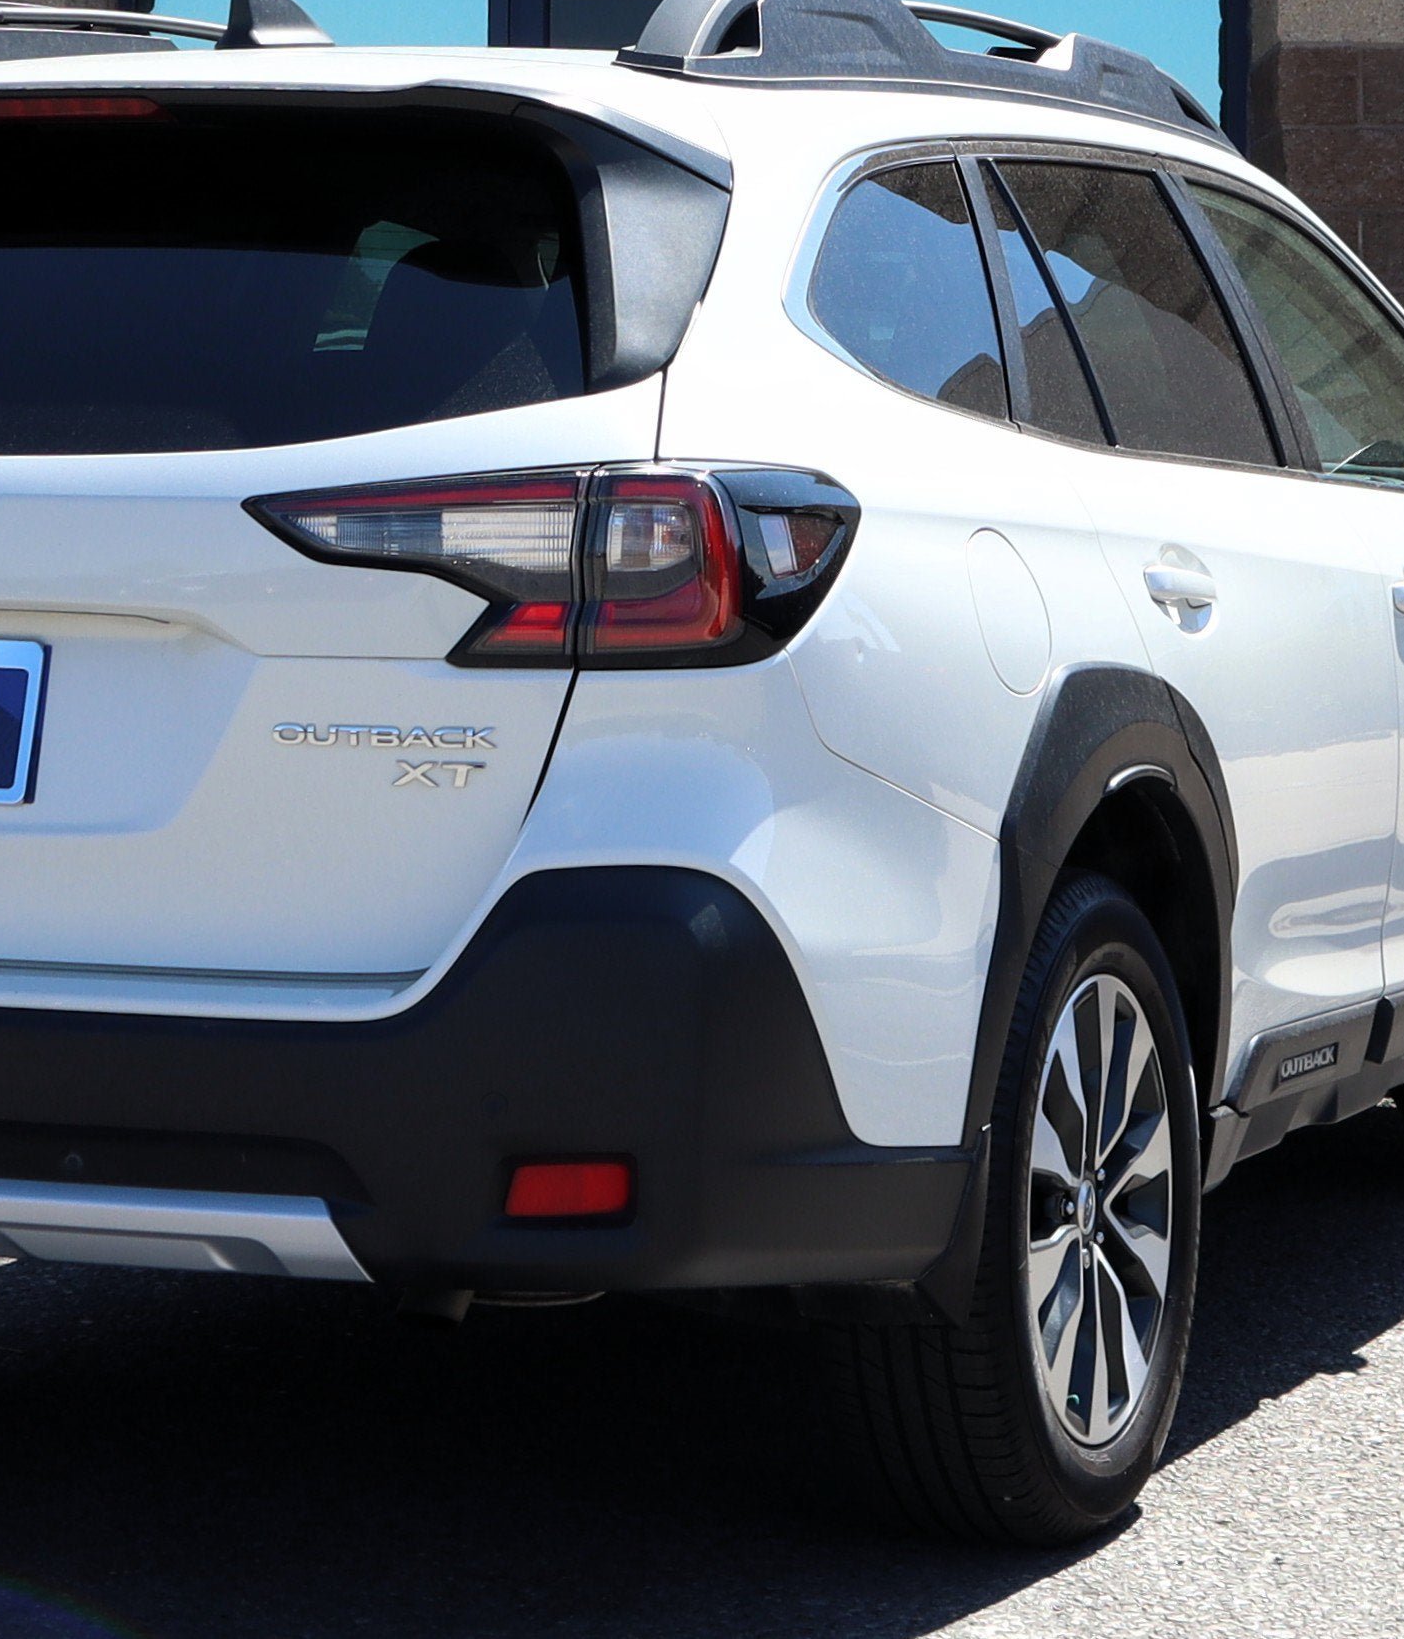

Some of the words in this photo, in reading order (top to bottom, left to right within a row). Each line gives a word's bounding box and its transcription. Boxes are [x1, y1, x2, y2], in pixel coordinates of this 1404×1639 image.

[272, 722, 497, 749] OUTBACK
[392, 760, 486, 788] XT
[1281, 1045, 1336, 1078] OUTBACK
